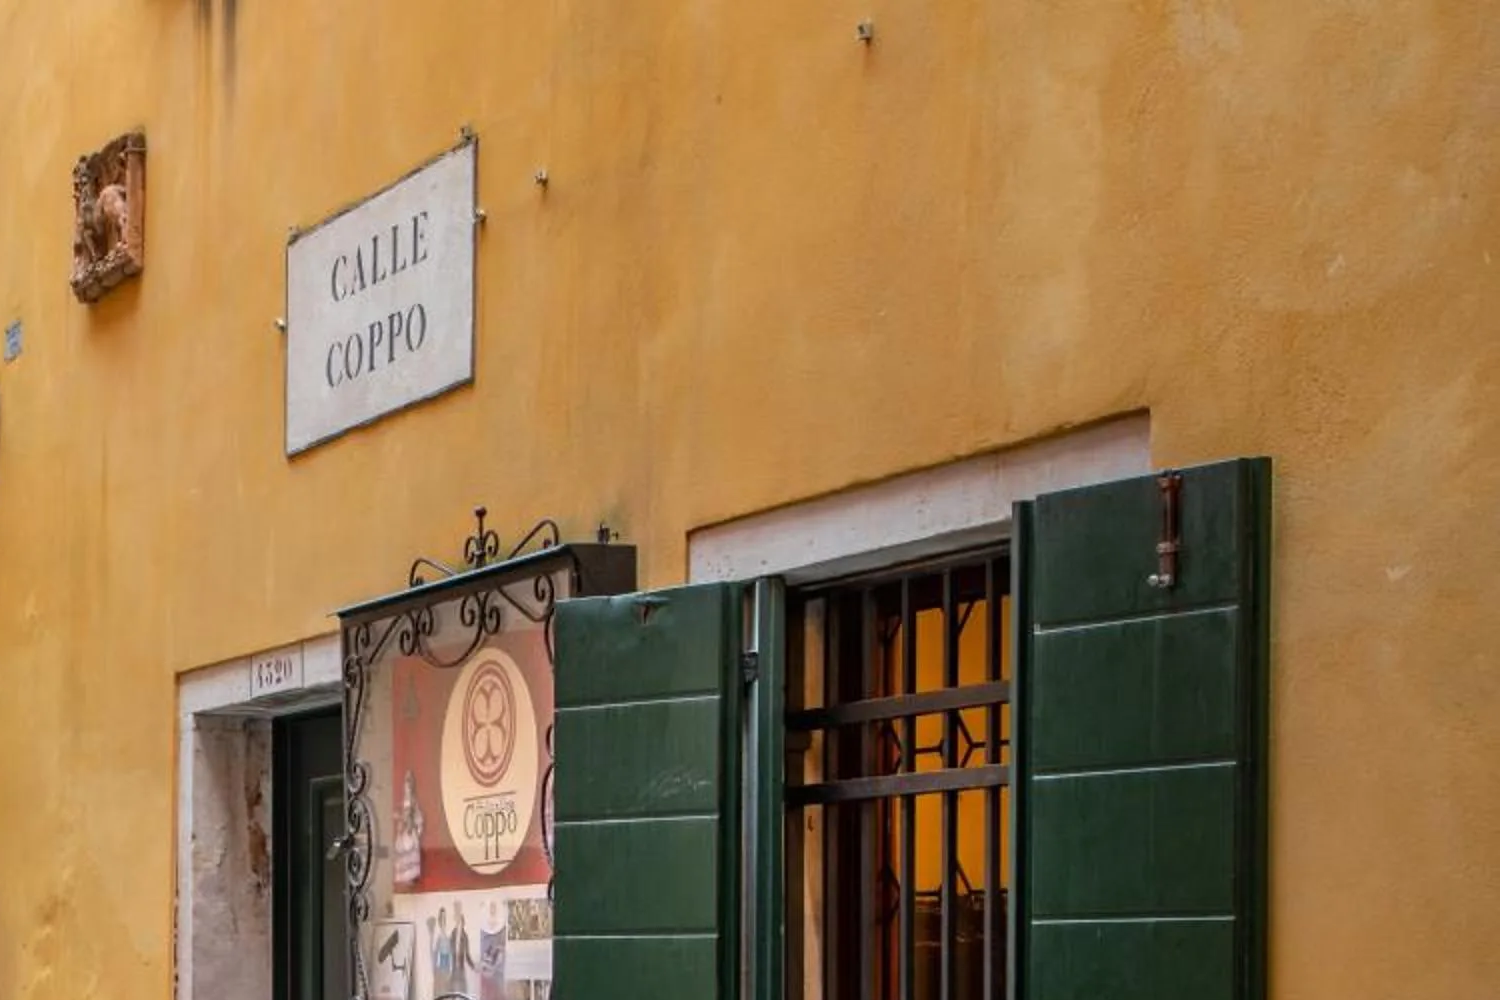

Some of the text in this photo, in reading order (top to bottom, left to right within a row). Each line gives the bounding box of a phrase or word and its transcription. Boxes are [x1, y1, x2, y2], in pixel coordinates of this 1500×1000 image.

[330, 210, 429, 302] CALLE
[326, 303, 428, 388] COPPO
[463, 803, 518, 861] Coppo
